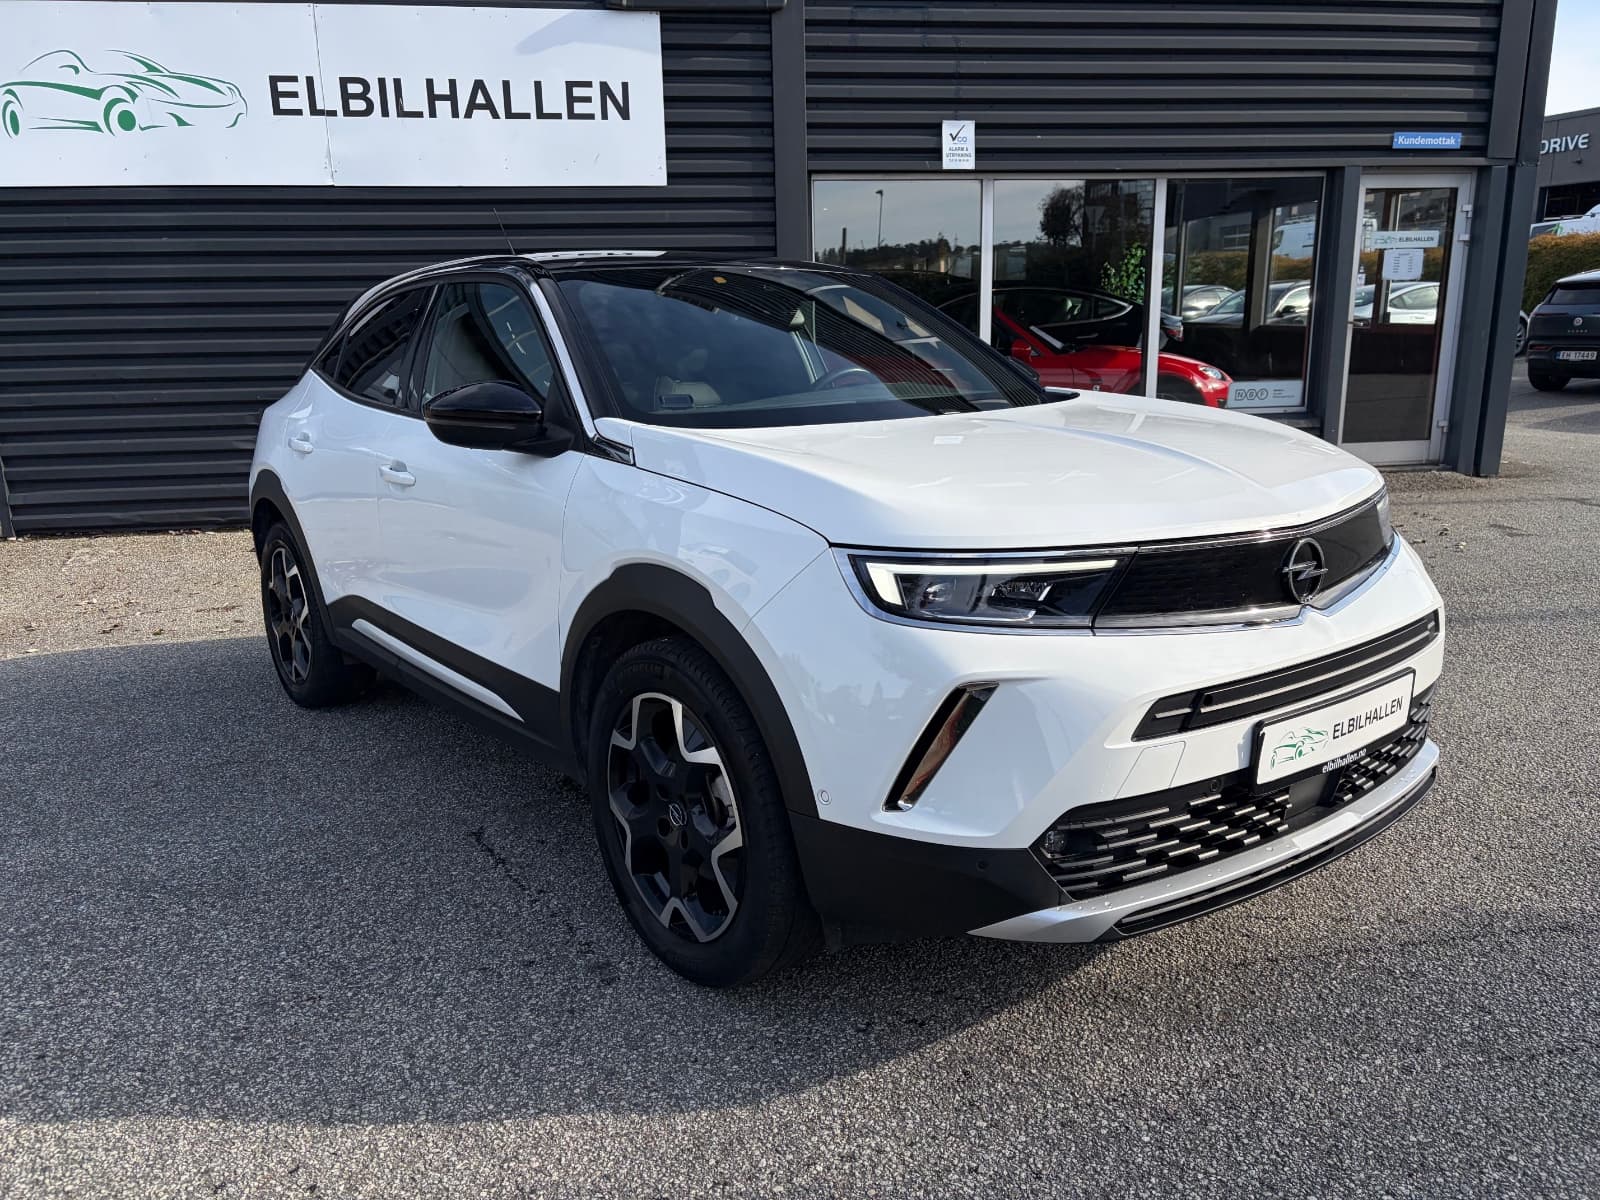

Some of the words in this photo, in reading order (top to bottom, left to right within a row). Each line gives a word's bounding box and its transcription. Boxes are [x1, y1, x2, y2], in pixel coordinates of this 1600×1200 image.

[268, 74, 631, 121] ELBILHALLEN
[1397, 135, 1456, 145] Kundemottak
[1398, 235, 1434, 243] ELBILHALLEN
[1332, 696, 1404, 740] ELBILHALLEN
[1322, 748, 1367, 773] elbilhallen.no
